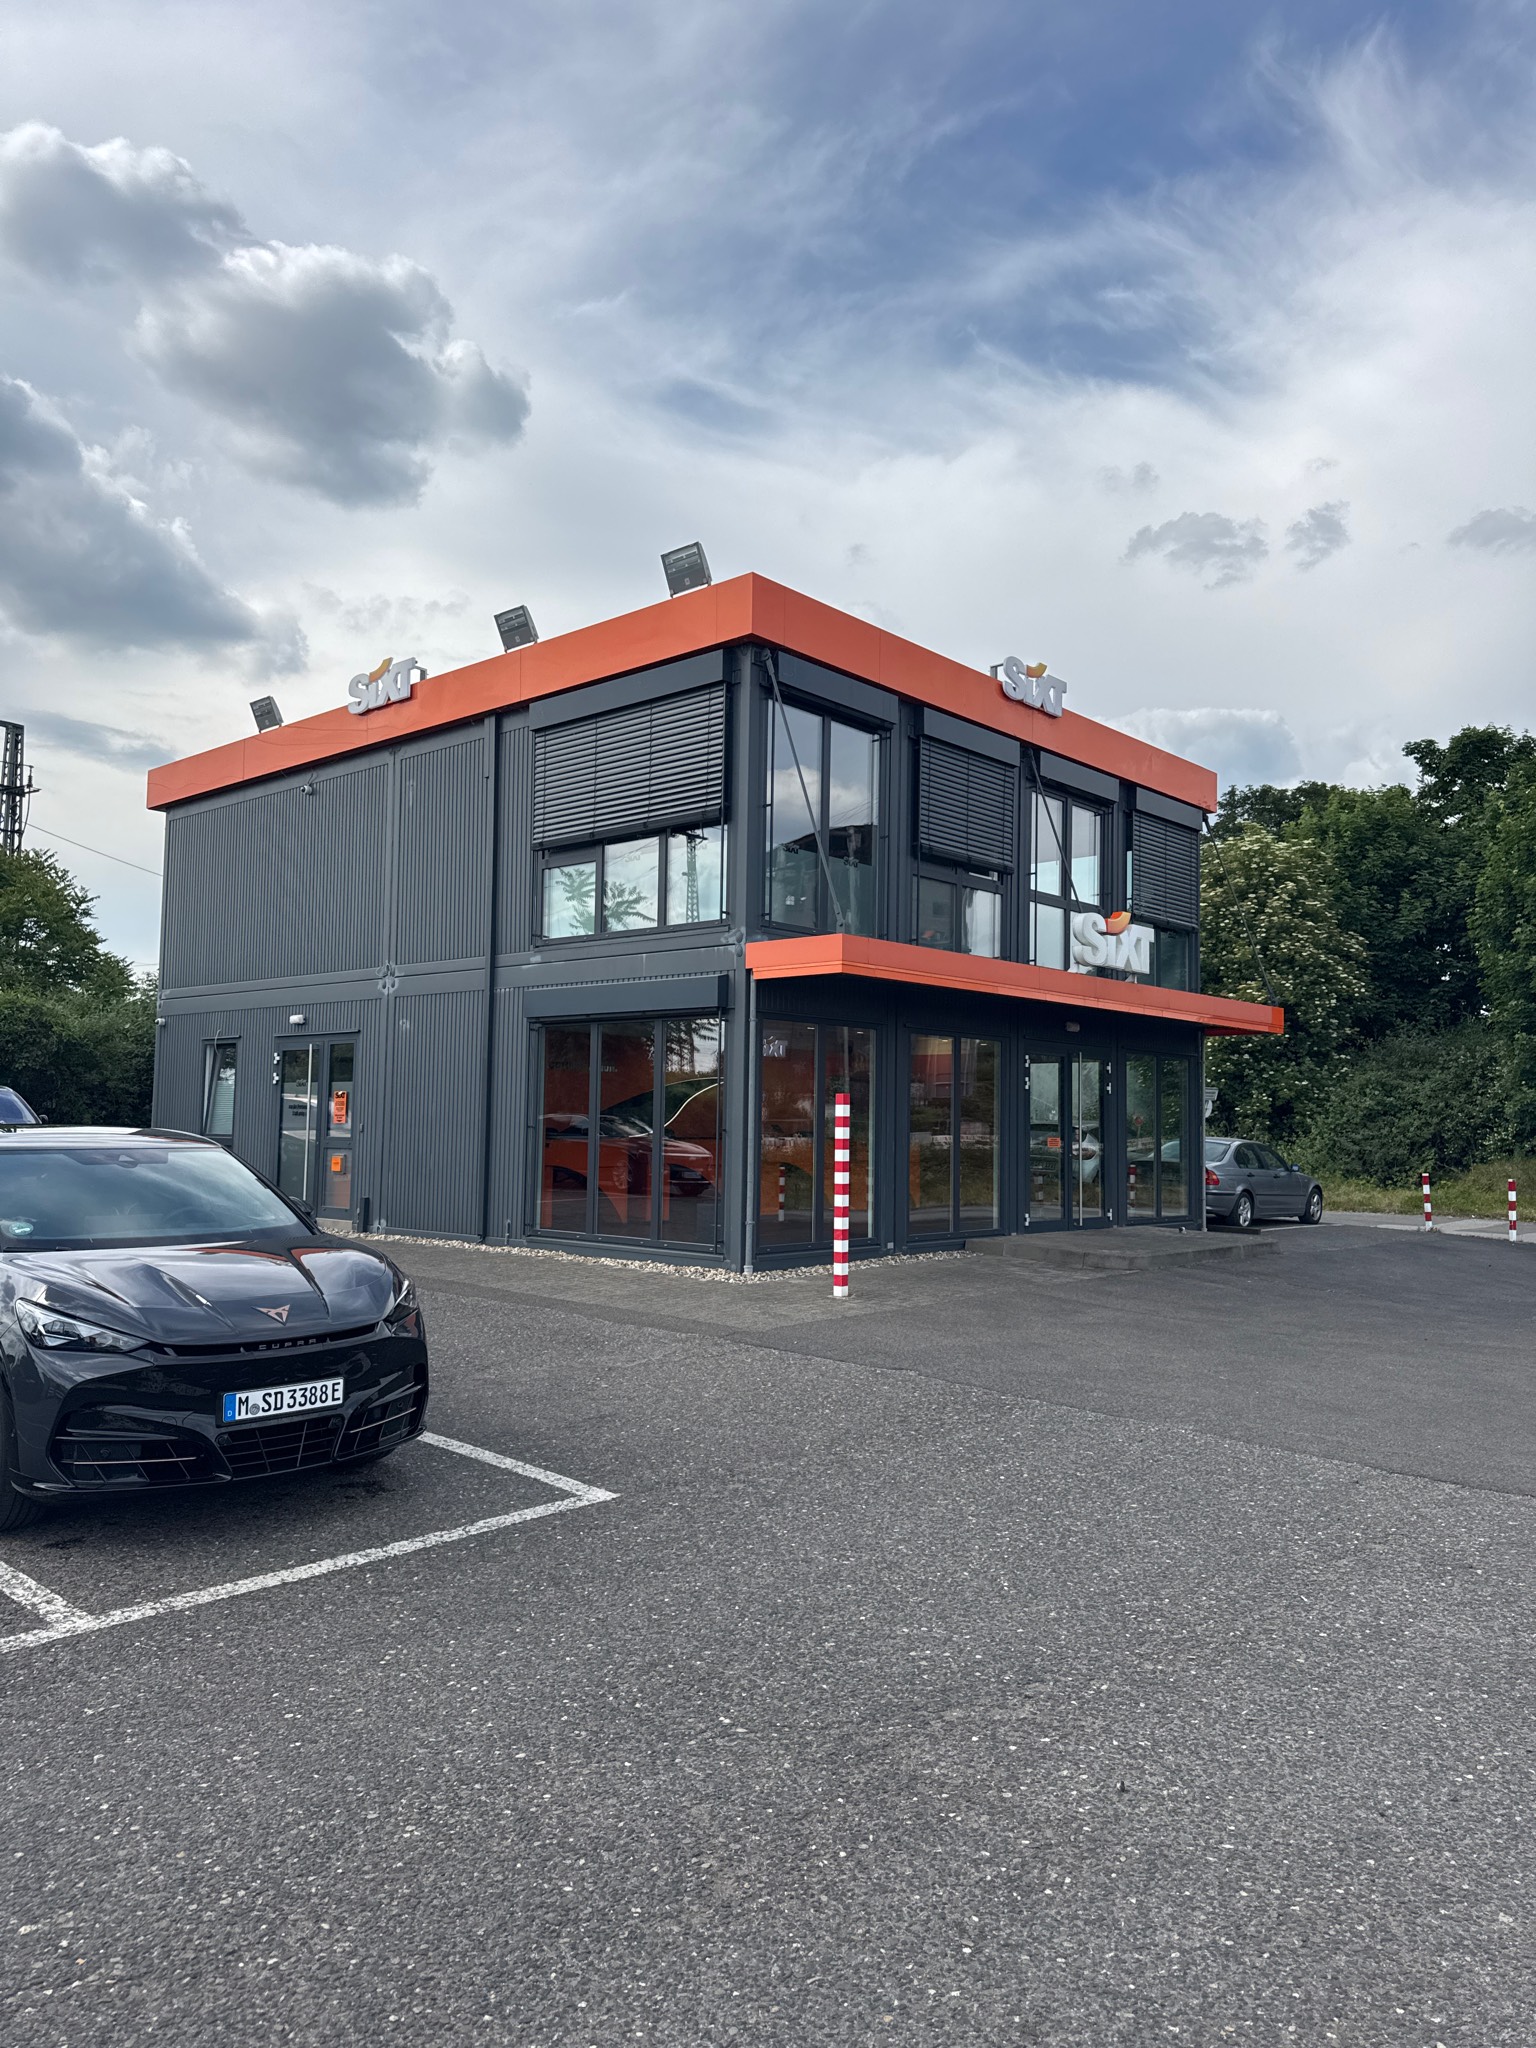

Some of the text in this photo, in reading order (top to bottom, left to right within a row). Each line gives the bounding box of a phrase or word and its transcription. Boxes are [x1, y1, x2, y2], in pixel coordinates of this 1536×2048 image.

[347, 657, 416, 715] SIXT
[1002, 656, 1067, 717] SIXT
[1073, 911, 1155, 975] SIXT
[258, 1338, 317, 1349] CUPRA
